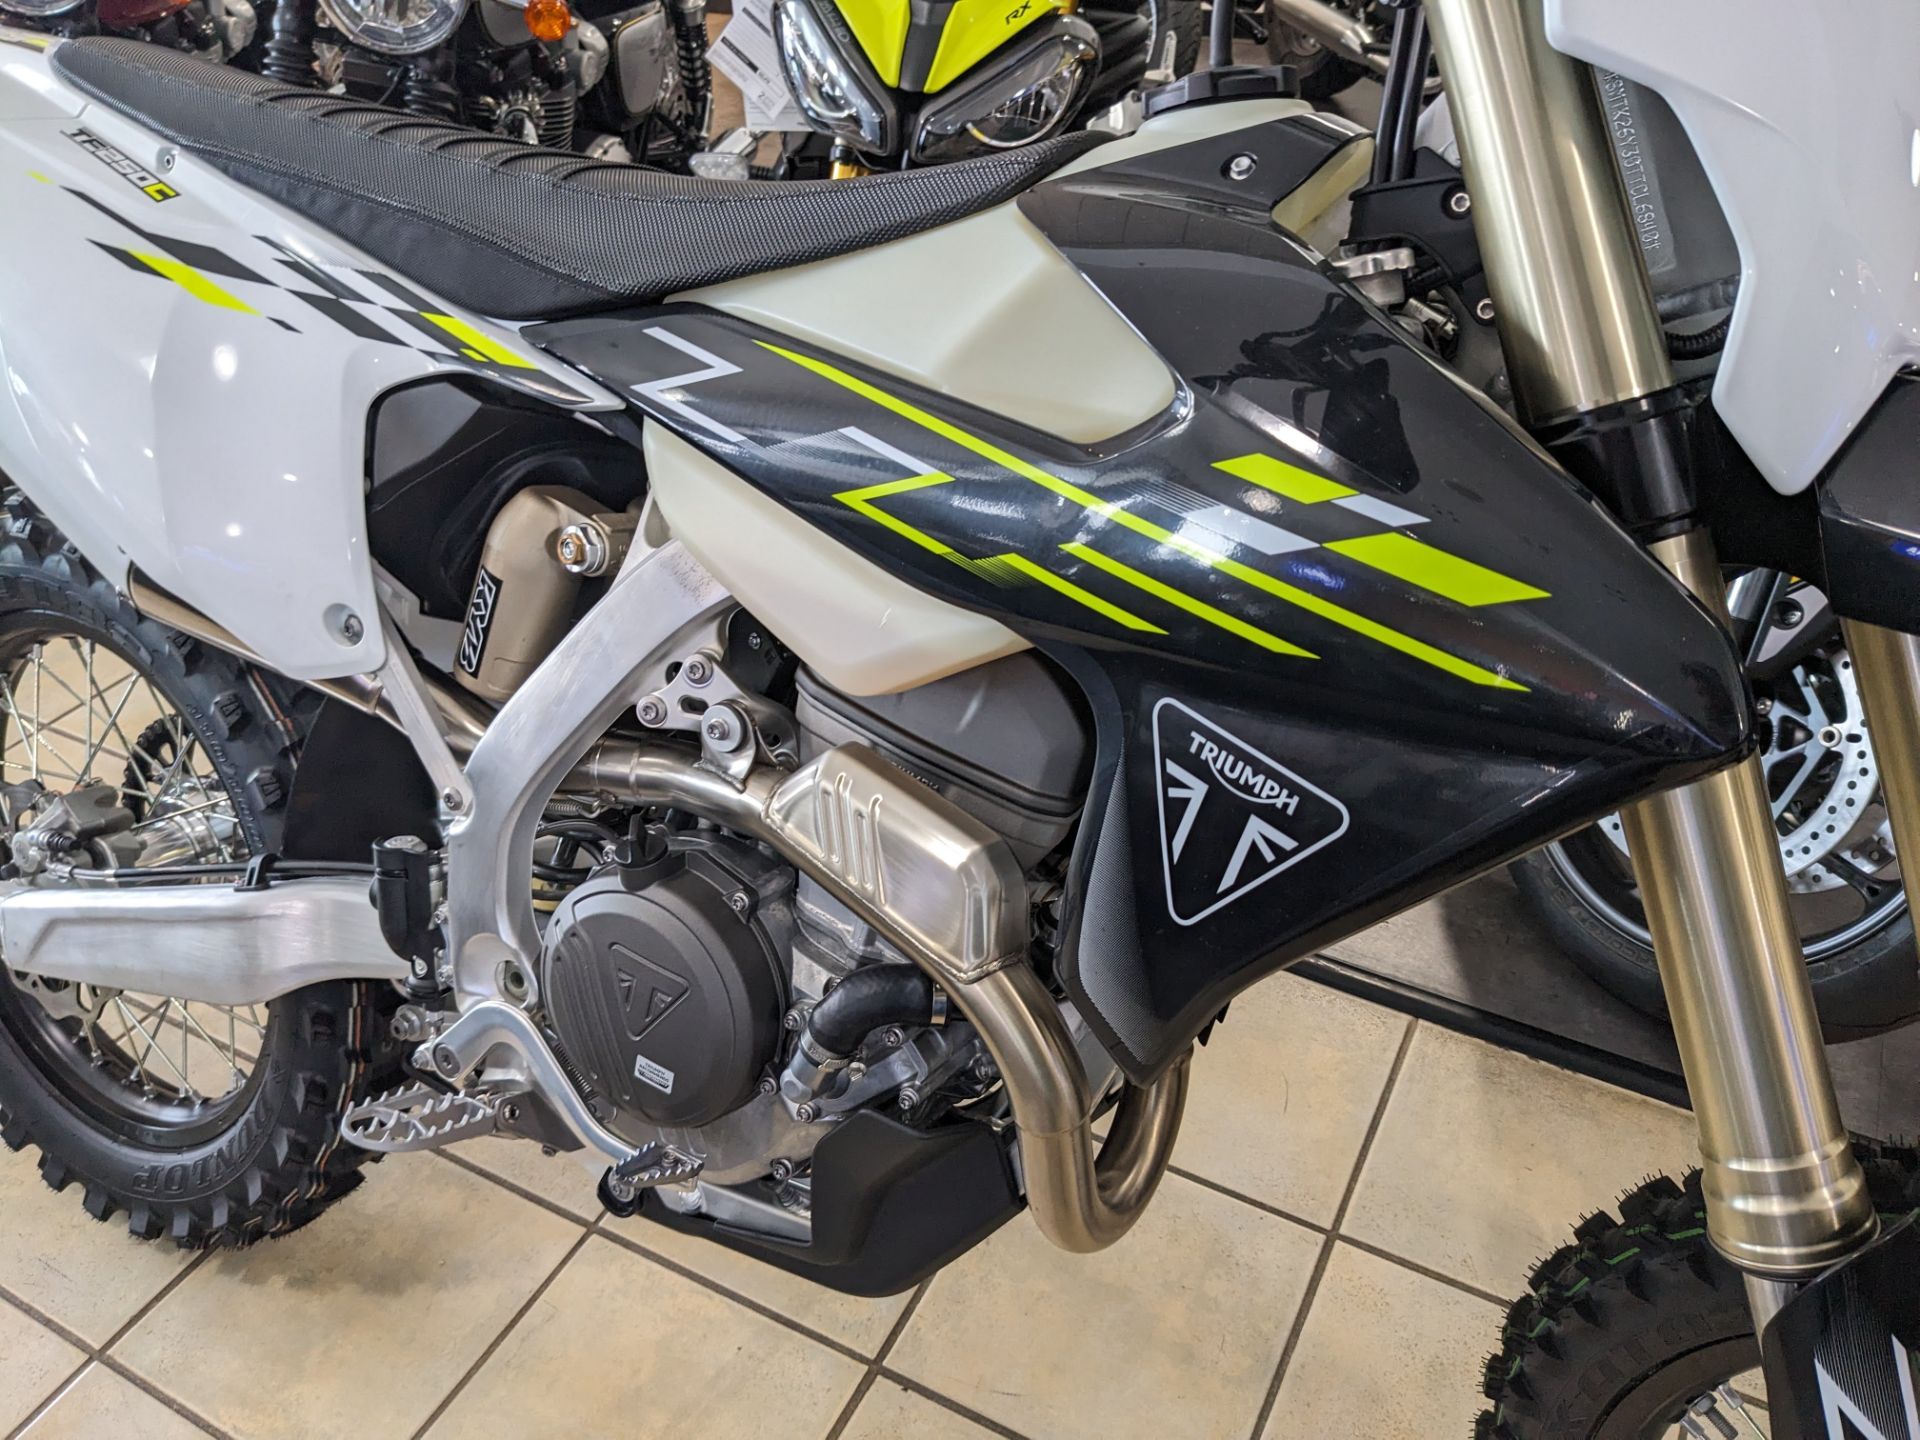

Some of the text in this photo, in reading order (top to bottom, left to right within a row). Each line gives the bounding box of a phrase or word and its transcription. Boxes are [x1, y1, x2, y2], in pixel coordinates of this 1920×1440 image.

[1005, 0, 1033, 26] RX
[69, 127, 180, 202] TF250C
[460, 568, 497, 673] KYB
[1189, 730, 1300, 817] TRIUMPH
